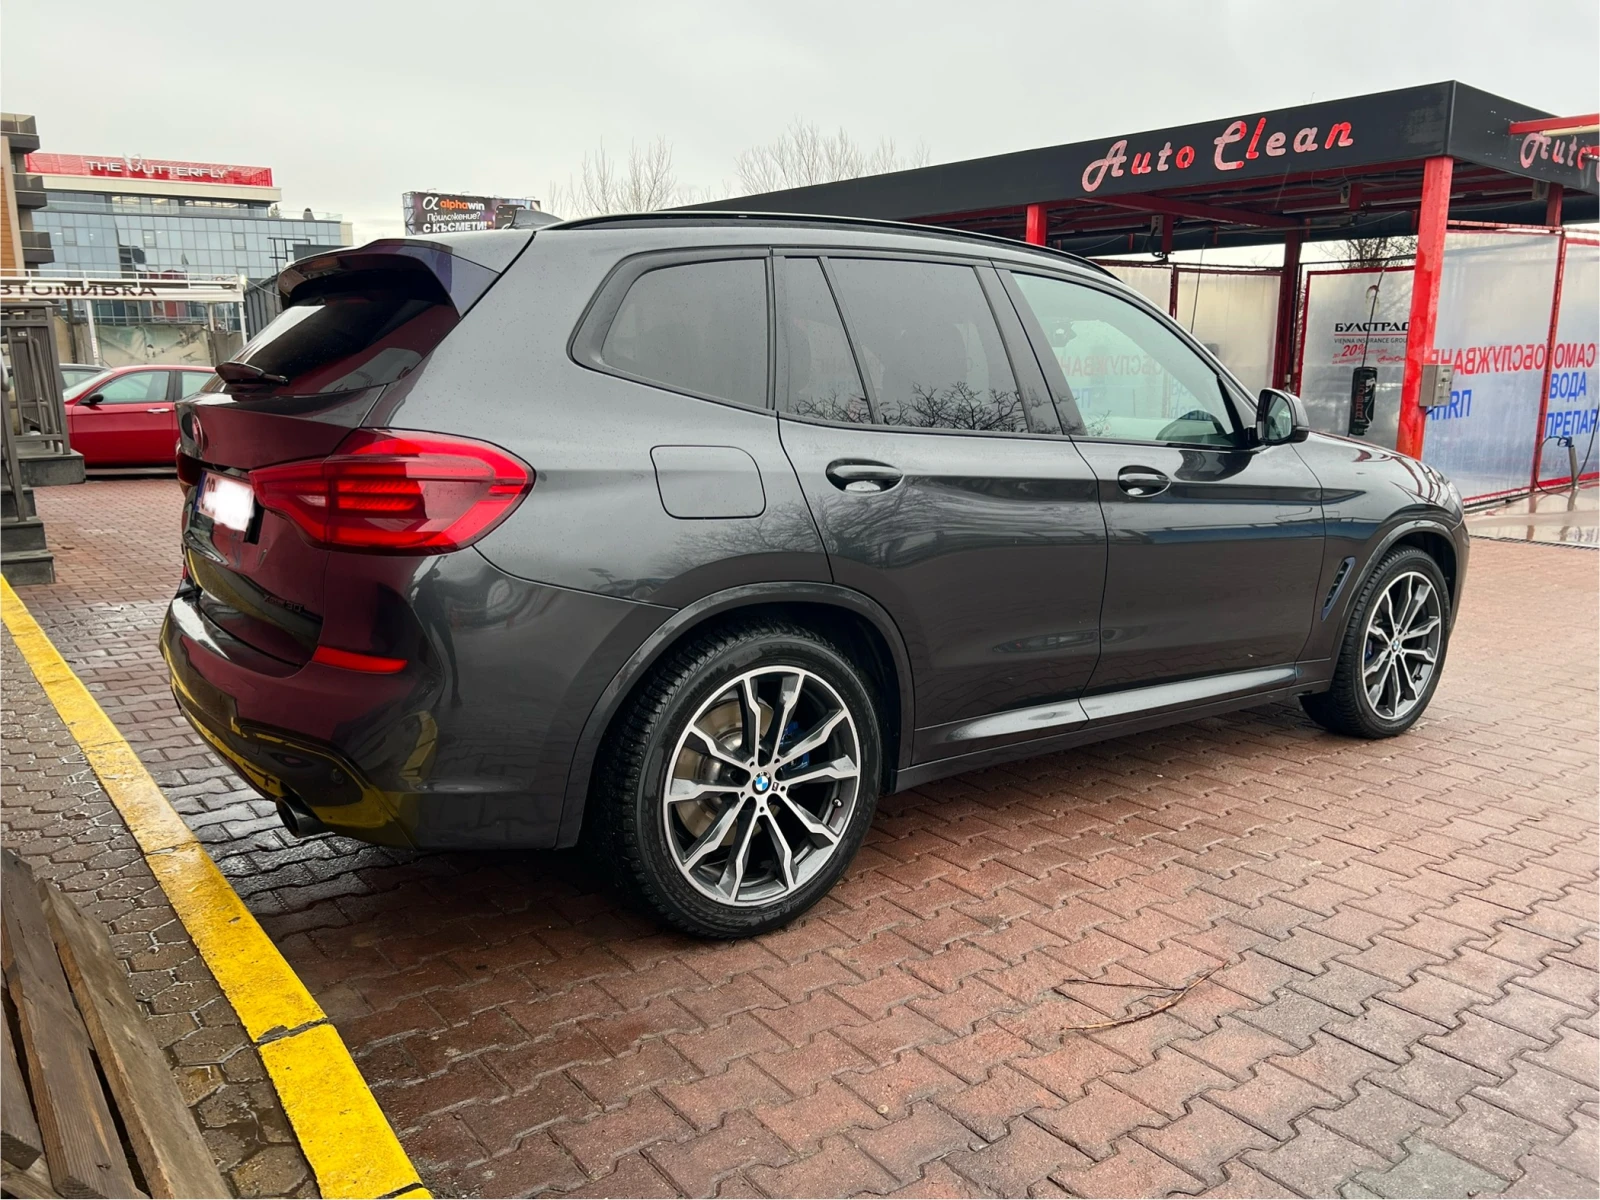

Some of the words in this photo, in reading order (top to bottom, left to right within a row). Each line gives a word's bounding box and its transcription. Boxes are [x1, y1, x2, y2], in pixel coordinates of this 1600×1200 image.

[1081, 139, 1195, 192] Auto
[1213, 117, 1354, 171] Clean
[86, 160, 123, 172] THE
[440, 199, 485, 211] alphawin
[427, 211, 481, 223] Приложение?
[432, 221, 488, 233] КЪСМЕТИ!
[1549, 371, 1587, 403] ВОДА
[1544, 408, 1600, 438] ПРЕПАР
